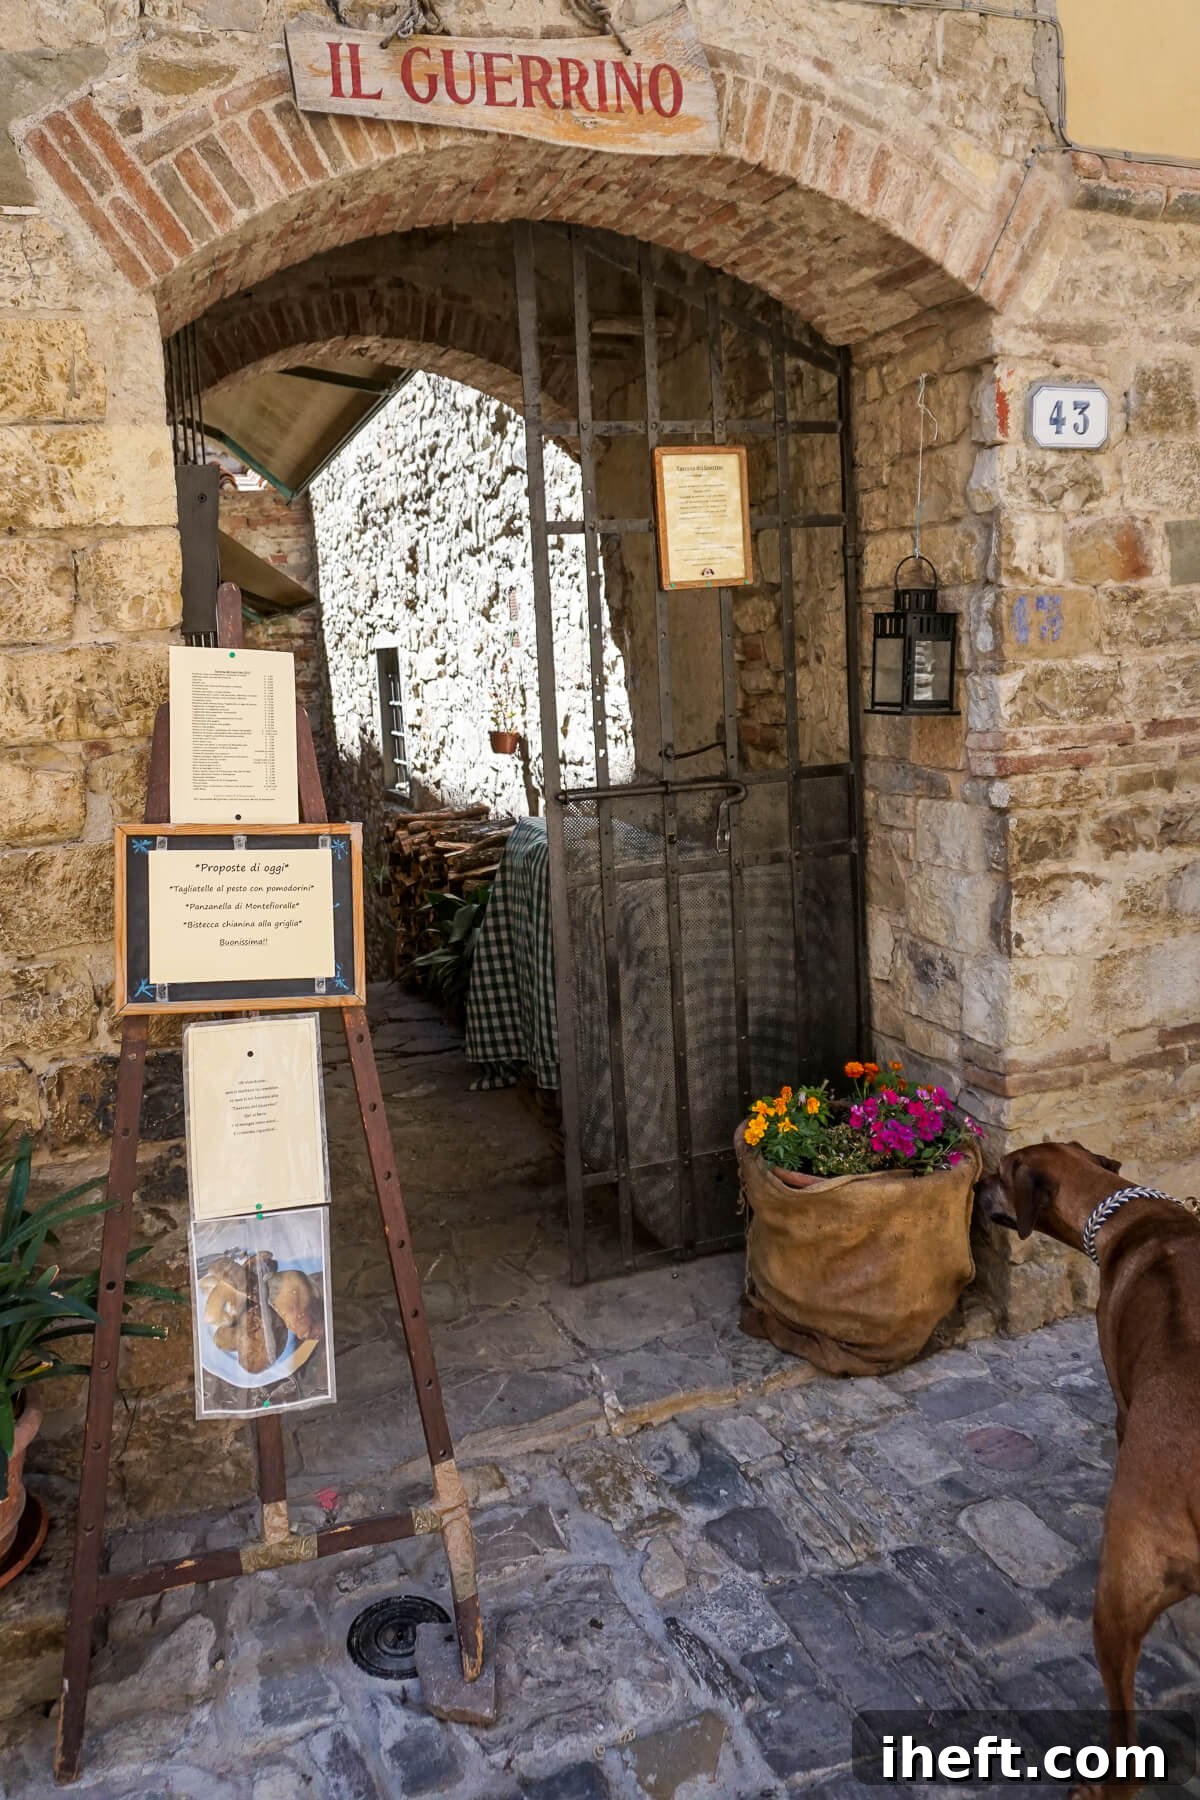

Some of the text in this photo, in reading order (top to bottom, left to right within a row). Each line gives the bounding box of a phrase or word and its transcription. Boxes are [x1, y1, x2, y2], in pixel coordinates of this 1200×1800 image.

[326, 41, 684, 118] IL GUERRINO
[1049, 399, 1091, 436] 43
[250, 862, 261, 873] di
[216, 884, 225, 893] al
[226, 885, 248, 896] pesto
[249, 885, 264, 893] con
[234, 902, 244, 911] di
[221, 919, 256, 929] chianina
[257, 919, 272, 928] alla
